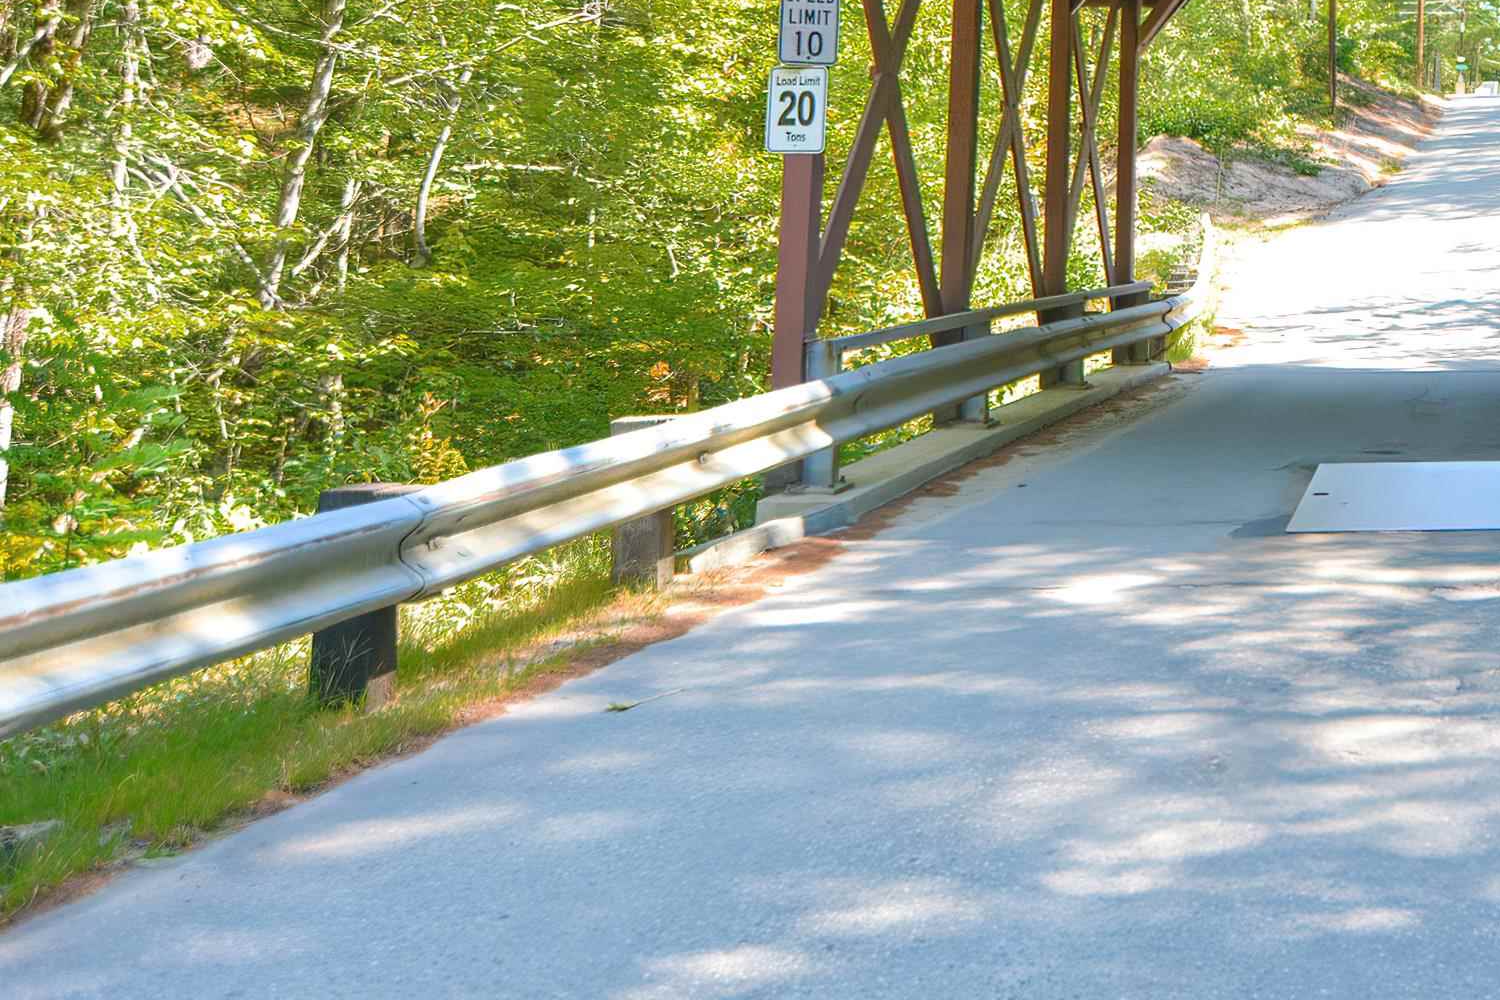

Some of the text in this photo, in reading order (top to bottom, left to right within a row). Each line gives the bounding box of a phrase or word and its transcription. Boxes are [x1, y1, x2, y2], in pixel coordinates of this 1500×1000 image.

[789, 8, 832, 25] LIMIT
[794, 31, 823, 57] 10
[776, 76, 821, 87] Load Limit
[777, 90, 816, 127] 20
[786, 131, 807, 143] Tons
